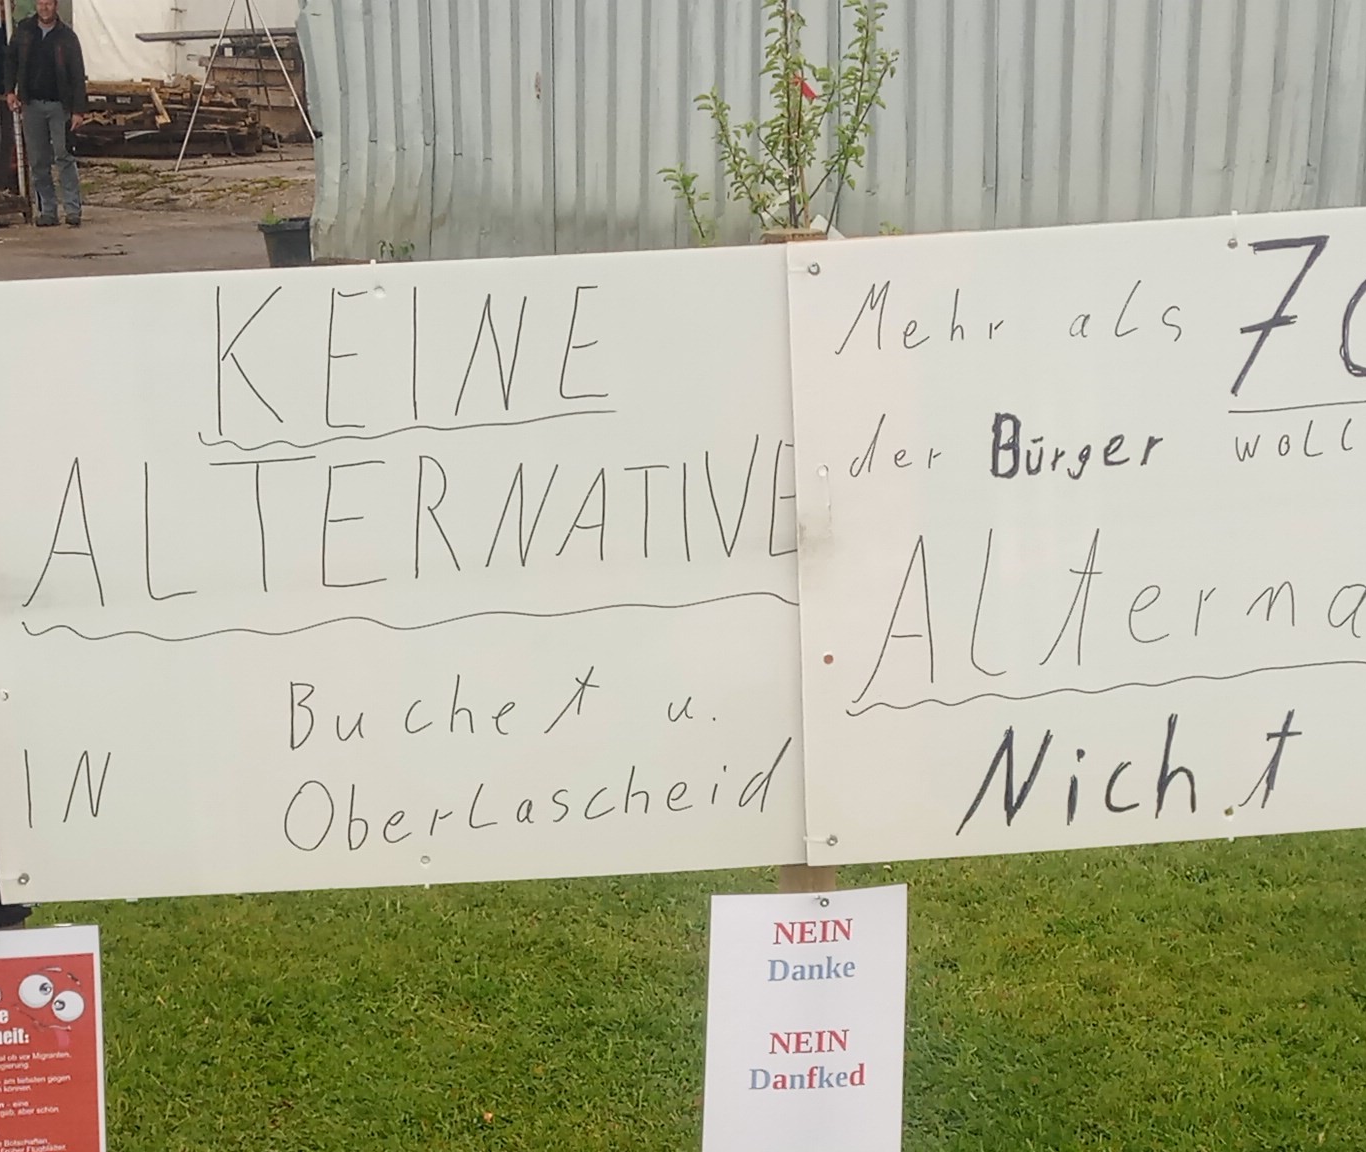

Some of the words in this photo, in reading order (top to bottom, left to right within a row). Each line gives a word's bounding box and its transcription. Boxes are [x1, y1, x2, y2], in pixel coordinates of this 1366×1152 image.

[836, 281, 1003, 355] Mehr
[1069, 281, 1181, 342] als
[216, 286, 609, 434] KEINE
[850, 414, 943, 478] der
[990, 412, 1163, 482] Bürger
[22, 435, 798, 607] ALTERNATIVE
[289, 666, 599, 750] Buchet
[667, 695, 717, 725] u.
[24, 749, 111, 827] IN
[773, 918, 853, 945] NEIN
[767, 956, 856, 982] Danke
[748, 1063, 866, 1091] Danfked
[768, 1029, 850, 1054] NEIN
